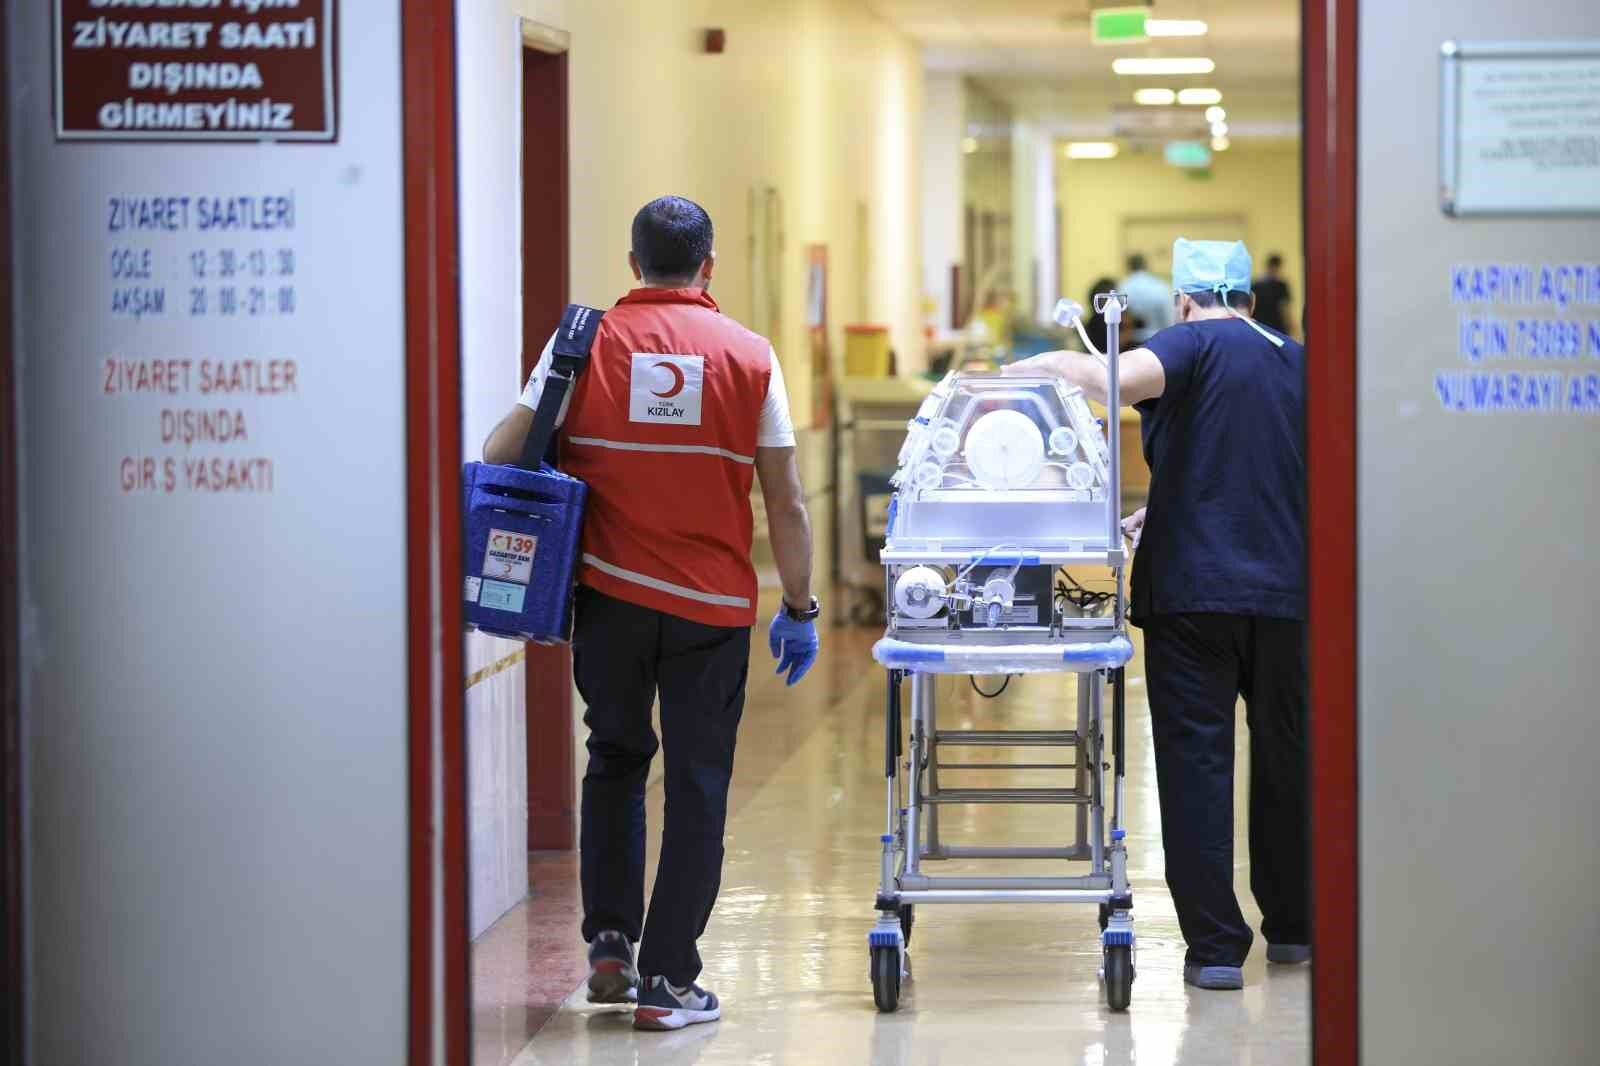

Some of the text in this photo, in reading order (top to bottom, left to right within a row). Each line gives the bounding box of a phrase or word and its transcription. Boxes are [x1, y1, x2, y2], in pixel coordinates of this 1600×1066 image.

[73, 16, 316, 48] ZİYARET SAATİ
[129, 62, 263, 94] DIŞINDA
[98, 98, 294, 128] GİRMEYİNİZ
[647, 407, 685, 418] KIZILAY
